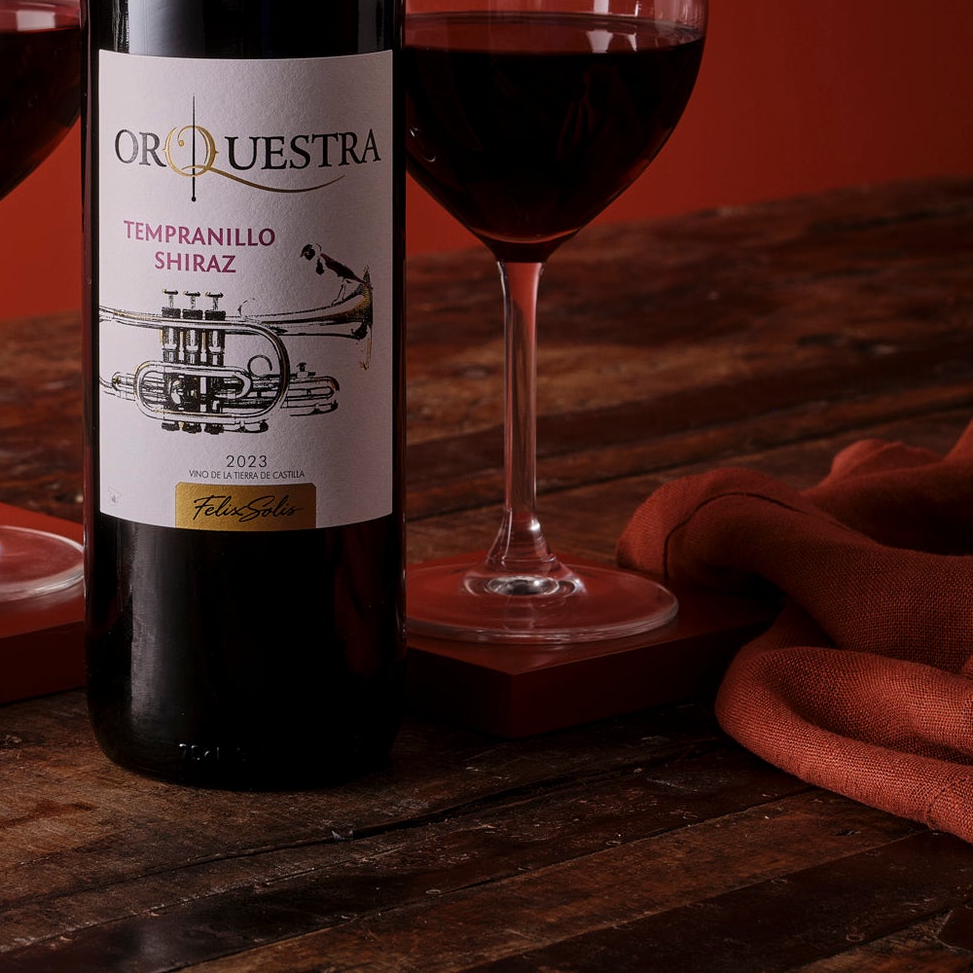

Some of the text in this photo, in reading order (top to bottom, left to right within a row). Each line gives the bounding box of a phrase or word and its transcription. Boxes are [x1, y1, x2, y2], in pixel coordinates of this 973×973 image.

[114, 124, 382, 193] ORQUESTRA
[123, 220, 276, 247] TEMPRANILLO
[154, 251, 237, 274] SHIRAZ
[225, 454, 268, 468] 2023
[188, 469, 306, 480] VINO DE LA TIERRA DE CASTILLA
